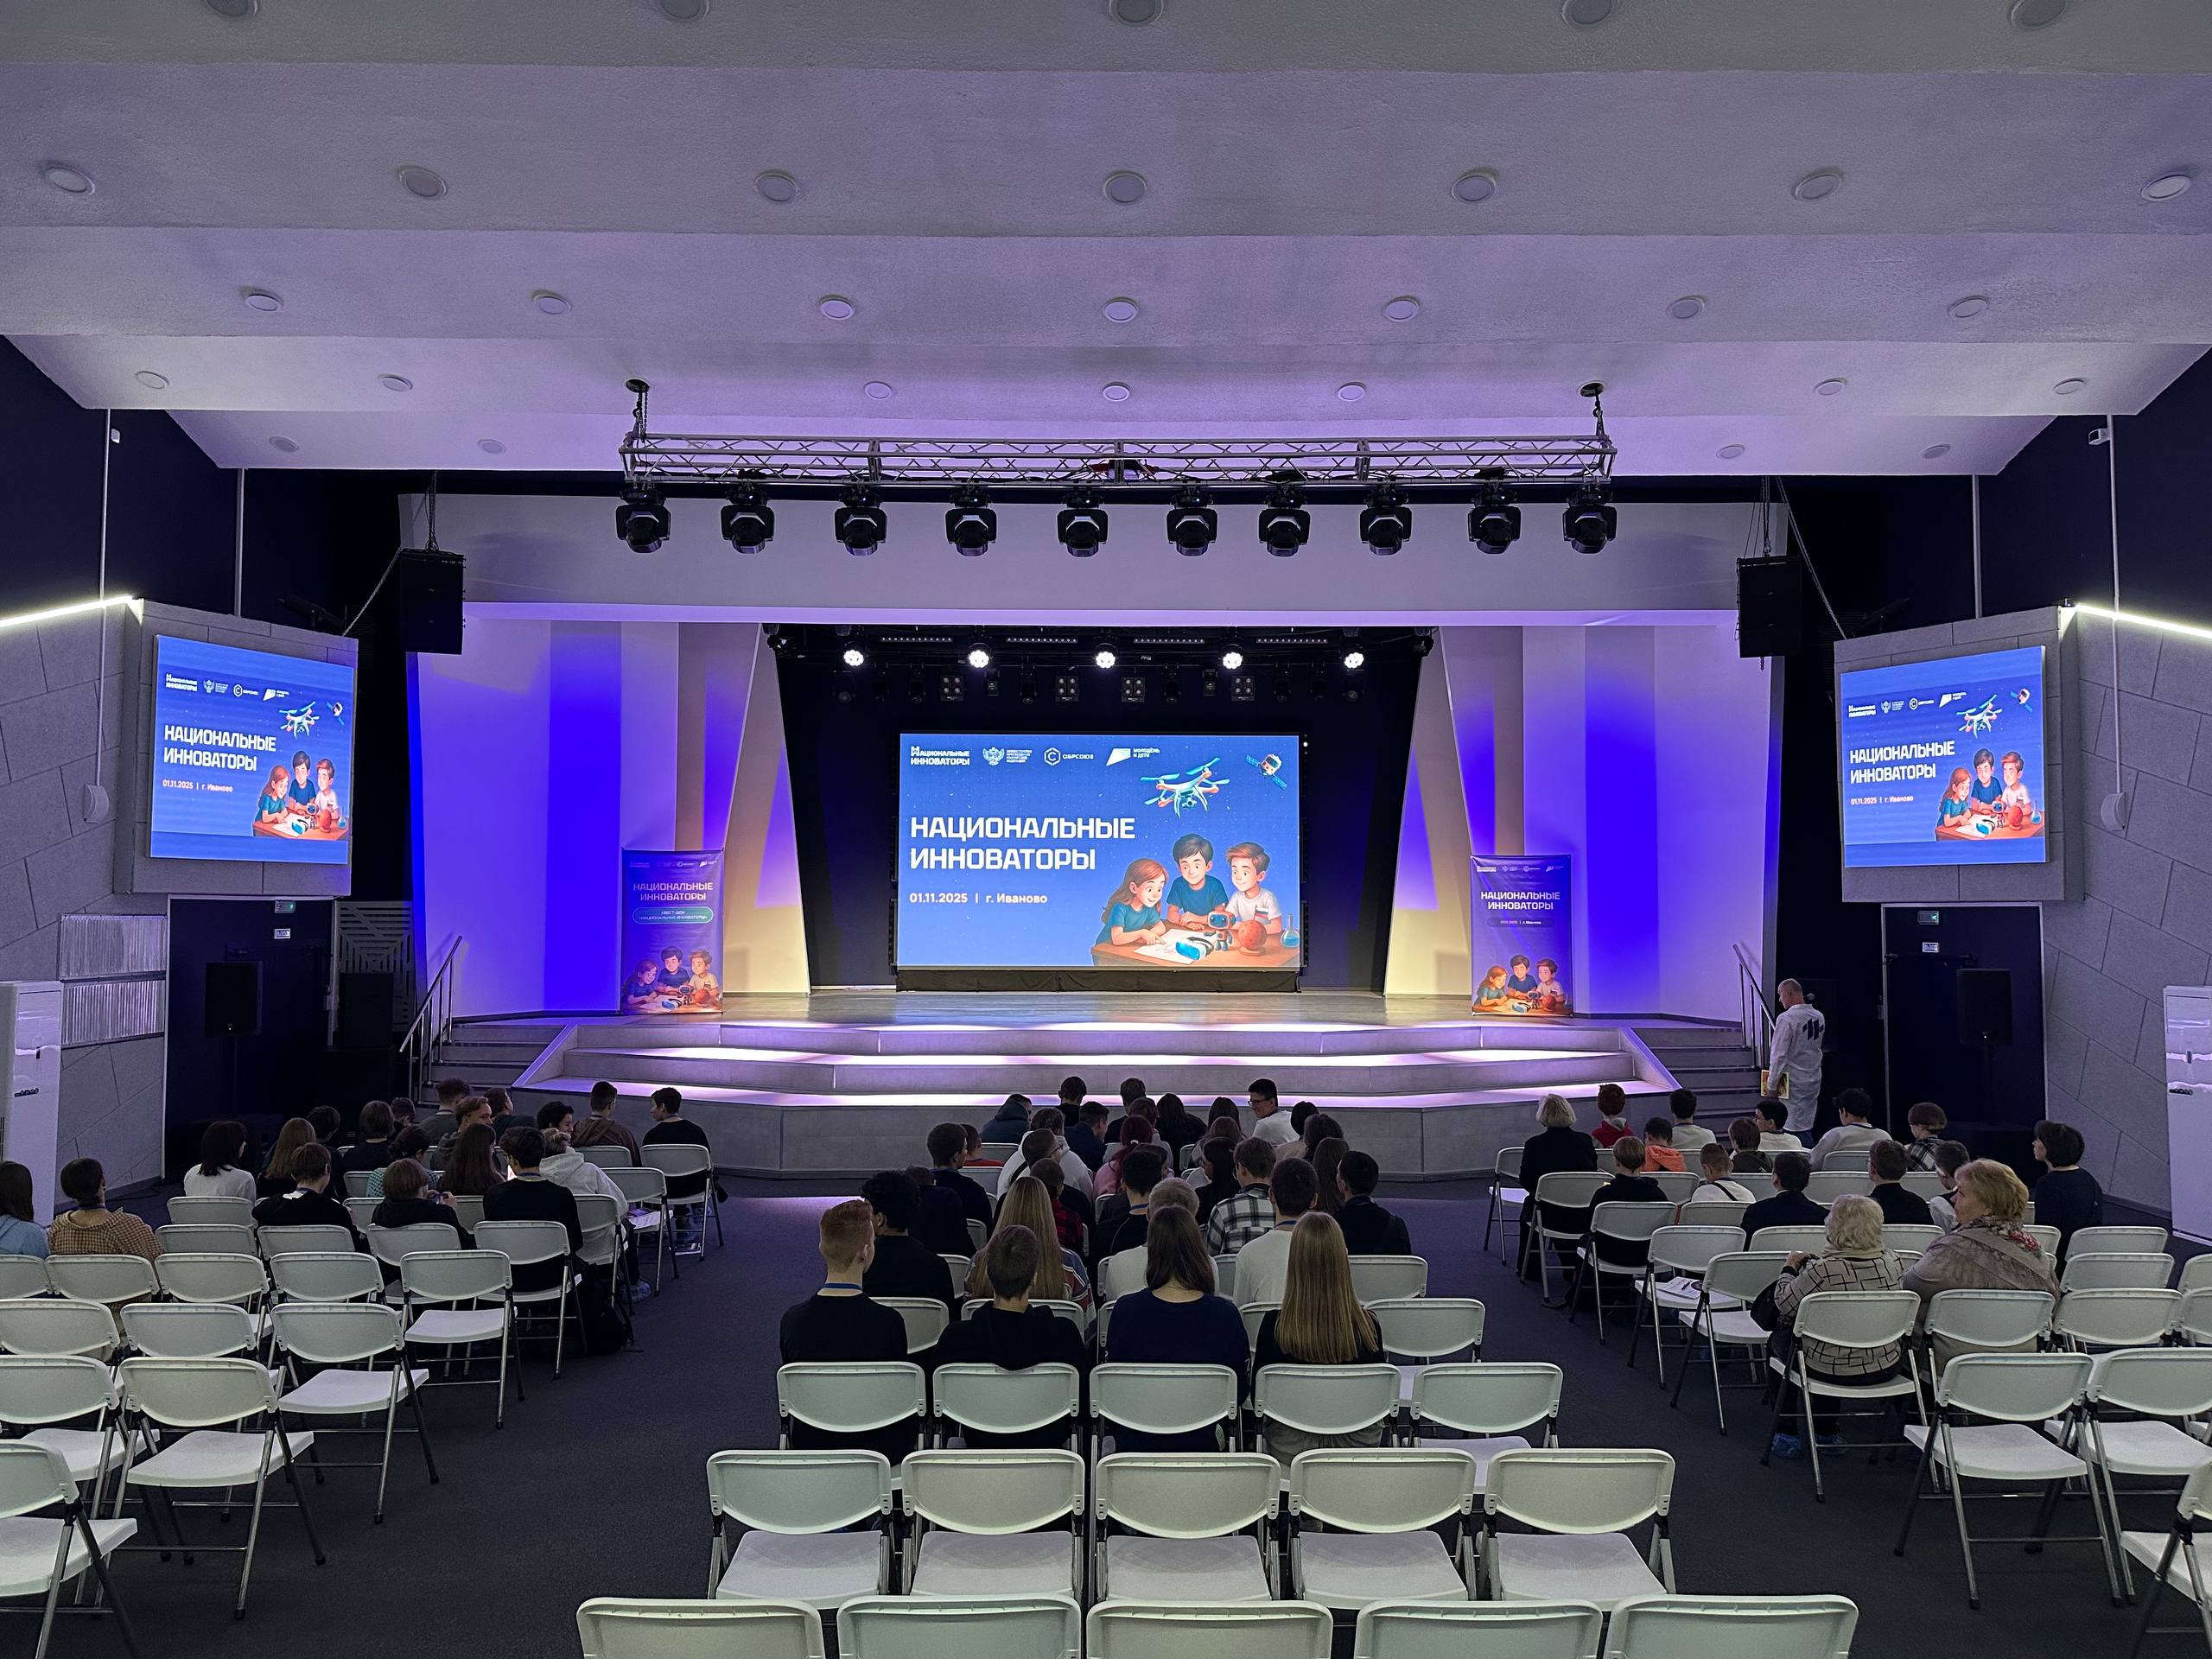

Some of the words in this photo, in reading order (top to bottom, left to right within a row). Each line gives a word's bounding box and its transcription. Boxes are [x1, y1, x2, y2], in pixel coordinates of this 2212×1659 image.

[164, 725, 276, 752] НАЦИОНАЛЬНЫЕ
[163, 747, 257, 772] ИННОВАТОРЫ
[911, 747, 970, 757] НАЦИОНАЛЬНЫЕ
[1850, 741, 1955, 765] НАЦИОНАЛЬНЫЕ
[1850, 763, 1936, 784] ИННОВАТОРЫ
[911, 817, 1135, 842] НАЦИОНАЛЬНЫЕ
[910, 848, 1096, 870] ИННОВАТОРЫ
[633, 882, 714, 892] НАЦИОНАЛЬНЫЕ
[640, 893, 706, 901] ИННОВАТОРЫ
[909, 893, 969, 903] 01.11.2025
[996, 893, 1048, 903] Иваново
[1480, 891, 1560, 900] НАЦИОНАЛЬНЫЕ
[1488, 901, 1554, 910] ИННОВАТОРЫ
